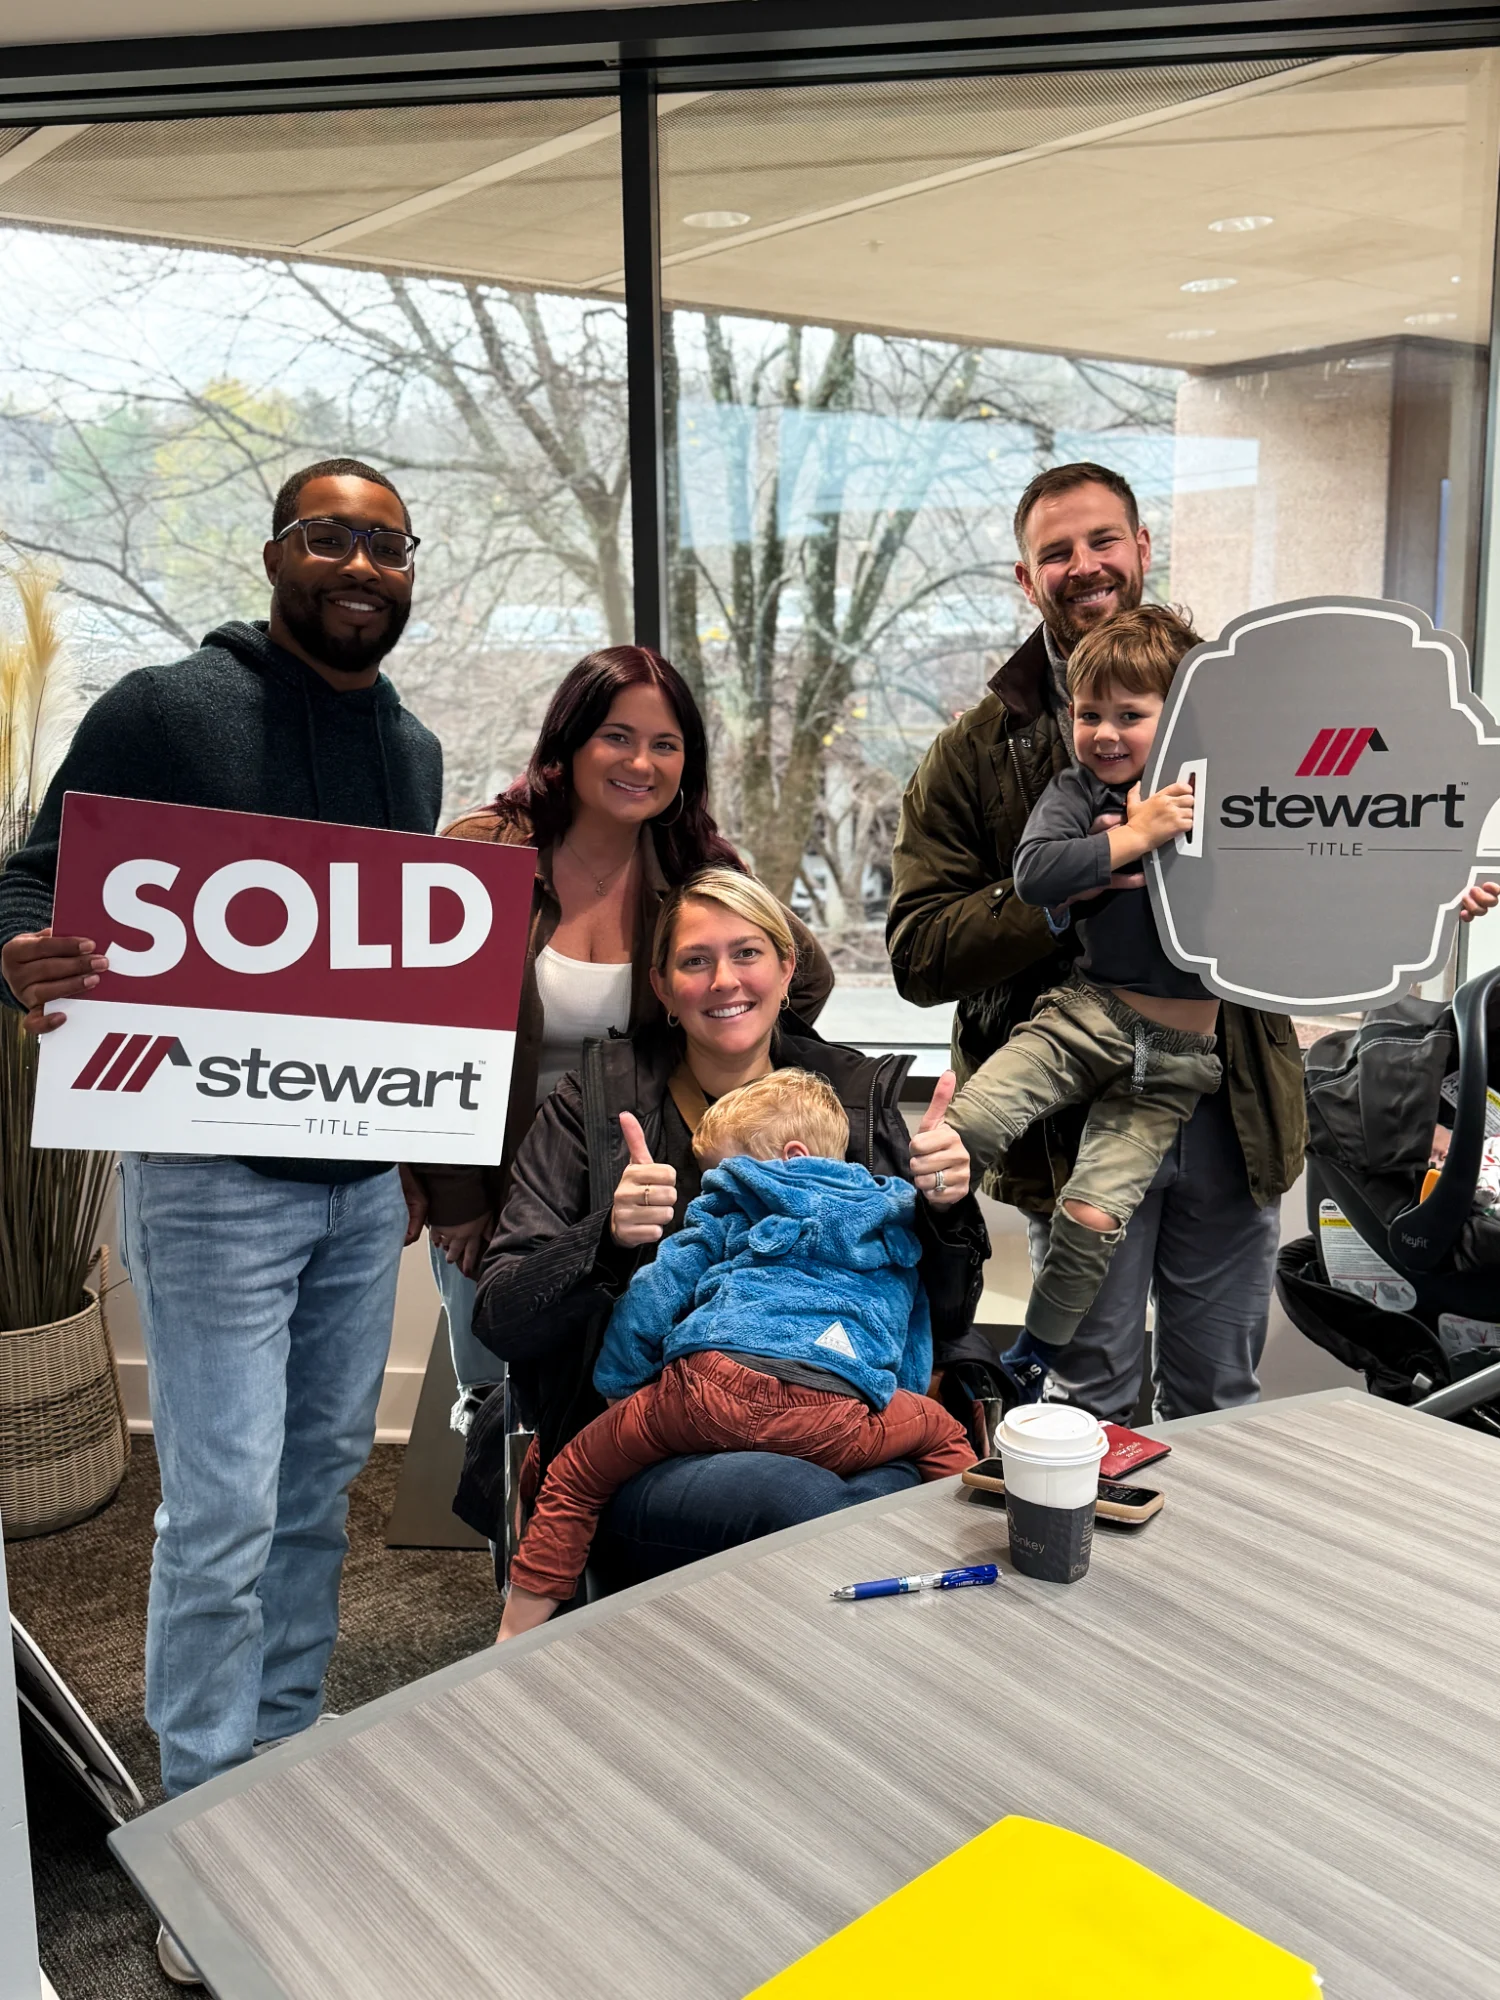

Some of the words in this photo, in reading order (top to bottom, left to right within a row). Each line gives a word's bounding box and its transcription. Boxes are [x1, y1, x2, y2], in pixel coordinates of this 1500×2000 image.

[1219, 784, 1466, 829] stewart
[1306, 842, 1363, 857] TITLE
[102, 858, 493, 977] SOLD
[195, 1047, 480, 1111] stewart
[304, 1118, 370, 1137] TITLE
[1011, 1534, 1045, 1554] onkey
